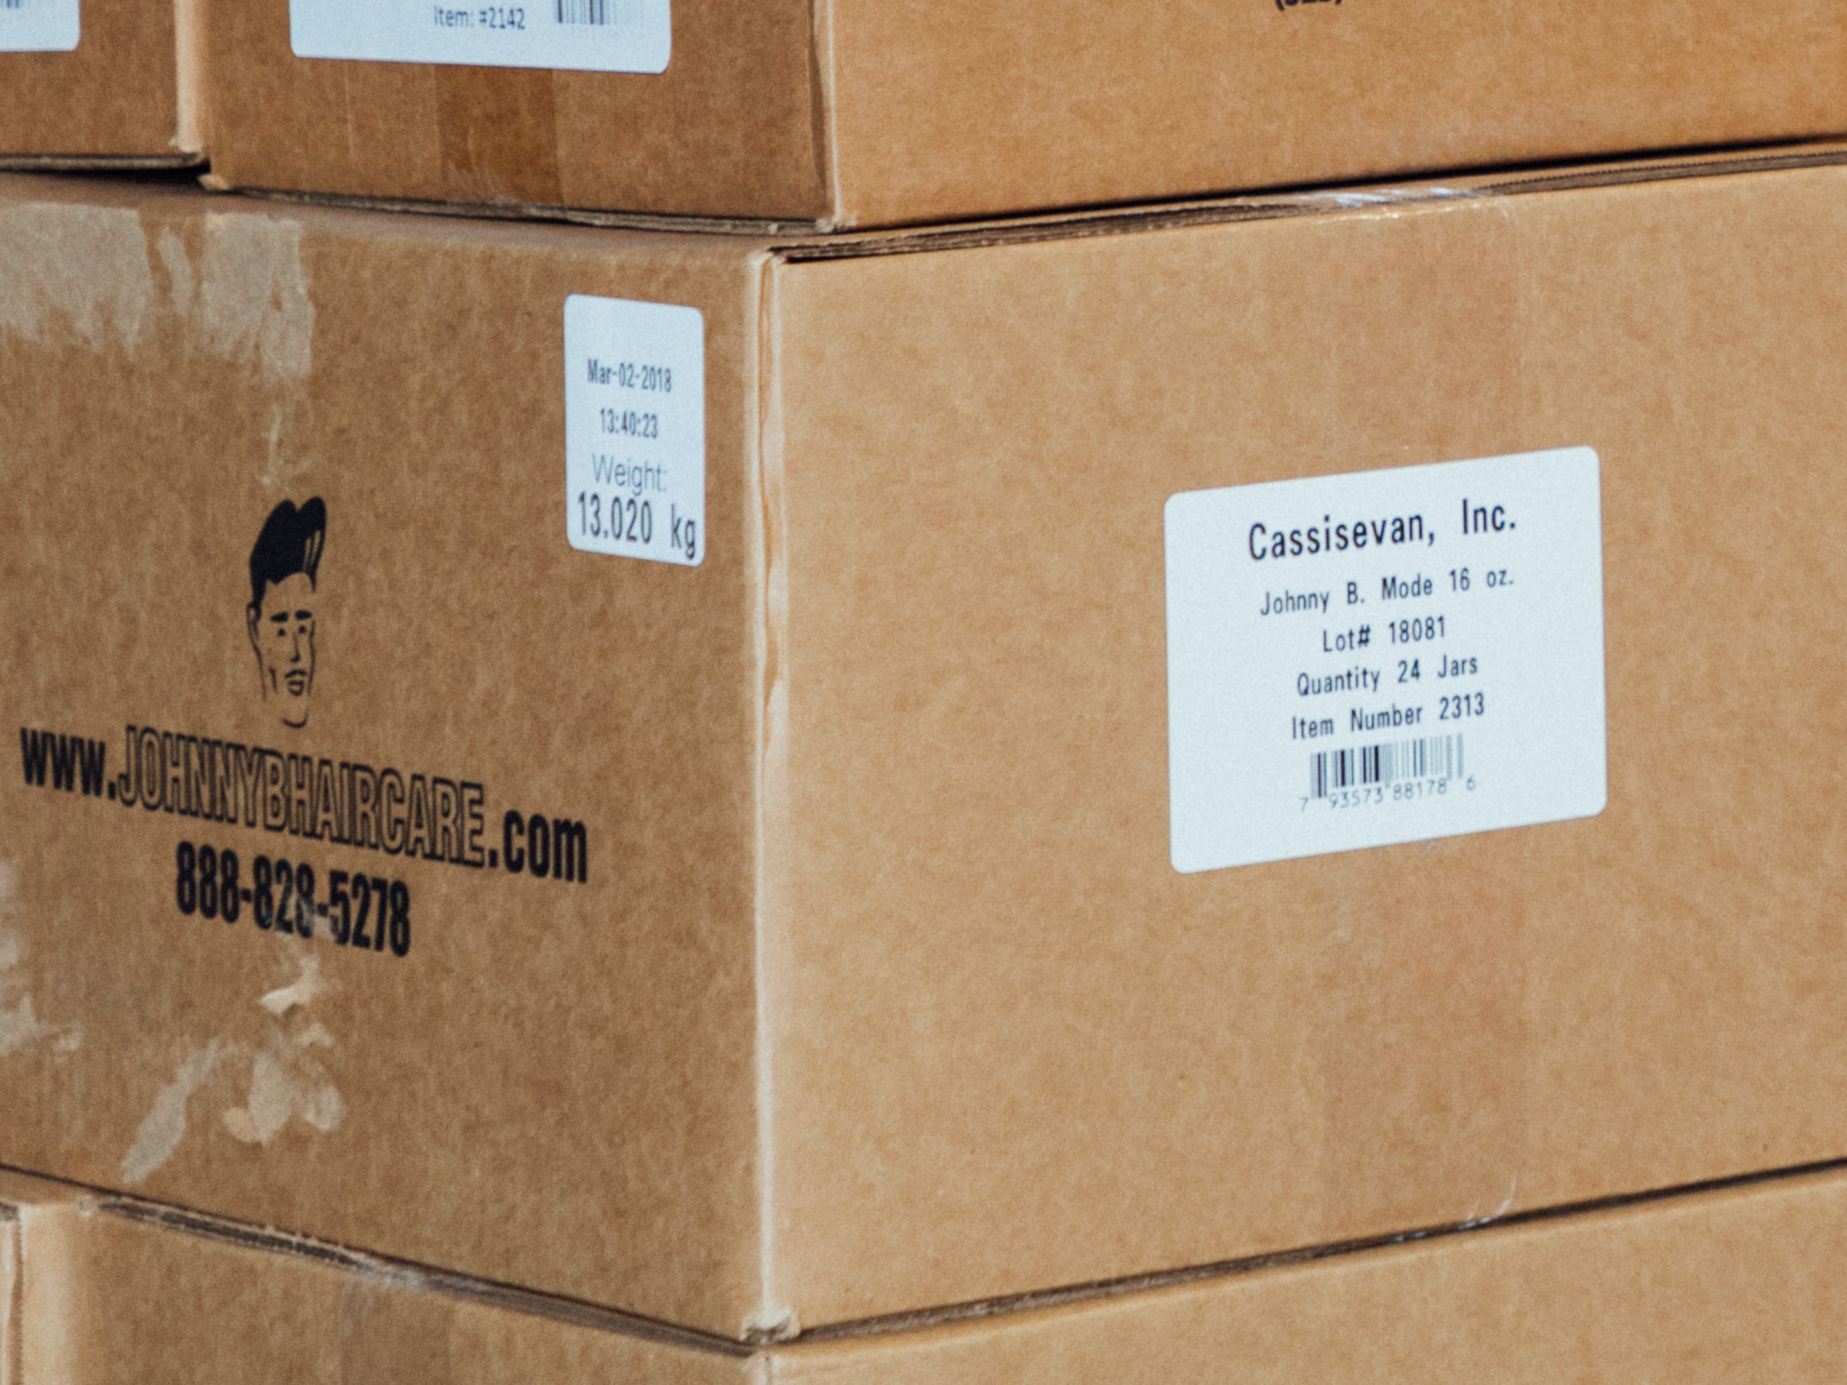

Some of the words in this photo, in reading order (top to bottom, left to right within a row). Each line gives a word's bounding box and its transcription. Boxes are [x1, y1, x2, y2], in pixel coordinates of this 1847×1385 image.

[432, 5, 476, 30] Item:
[478, 7, 527, 32] #2142
[586, 357, 673, 395] Mar-02-2018
[598, 406, 660, 441] 13:40:23
[591, 451, 668, 494] Weight:
[576, 489, 654, 546] 13.020
[669, 502, 697, 561] kg
[1247, 513, 1437, 562] Cassisevan,
[1460, 497, 1518, 537] Inc.
[1259, 588, 1331, 618] Johnny
[1345, 581, 1366, 606] B.
[1380, 573, 1434, 603] Mode
[1447, 567, 1472, 593] 16
[1485, 568, 1515, 590] oz.
[1321, 624, 1372, 654] Lot#
[1387, 615, 1447, 645] 18081
[1295, 665, 1382, 697] Quantity
[1397, 659, 1422, 686] 24
[1436, 653, 1479, 681] Jars
[1291, 714, 1335, 741] Item
[1349, 702, 1424, 733] Number
[1438, 691, 1486, 722] 2313
[19, 725, 589, 884] www.JOHNNYBHAIRCARE.com
[176, 840, 412, 958] 888-828-5278
